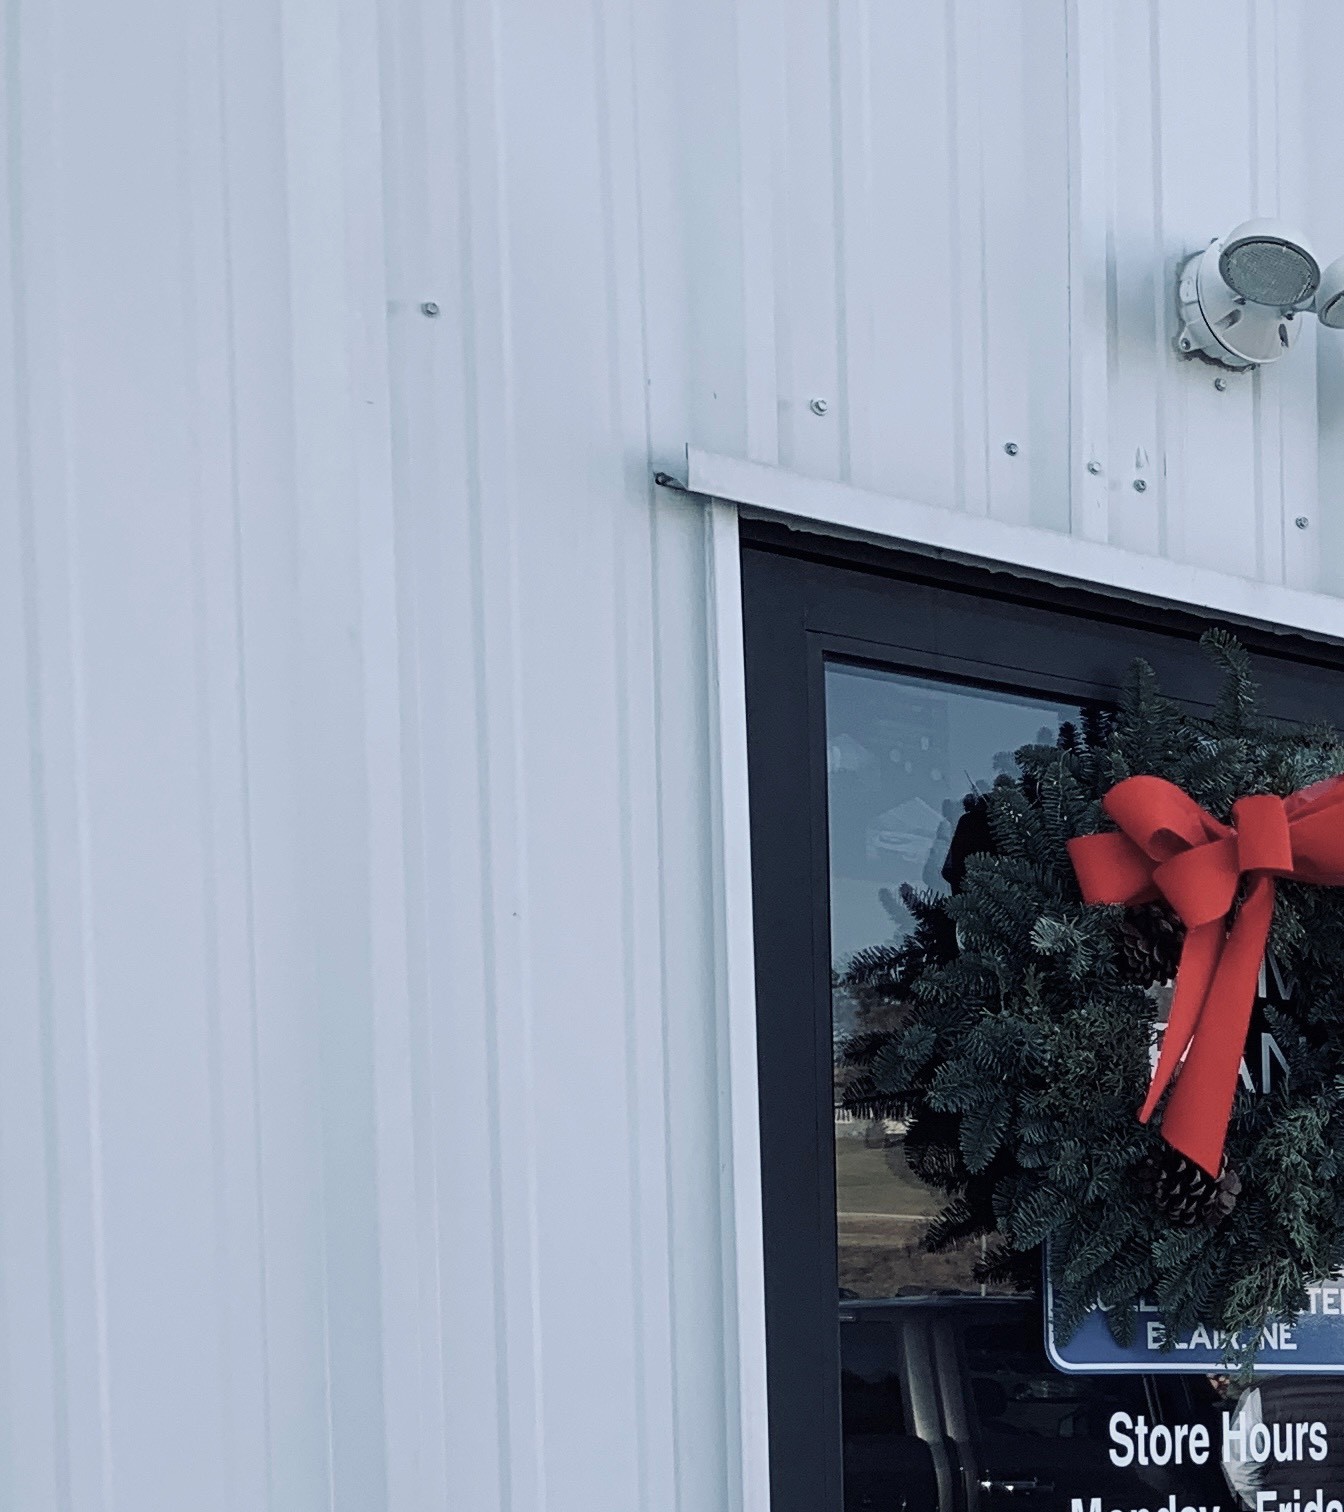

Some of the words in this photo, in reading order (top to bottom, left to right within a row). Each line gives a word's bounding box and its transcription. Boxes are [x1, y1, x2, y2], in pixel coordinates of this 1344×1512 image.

[1260, 1322, 1297, 1350] NE
[1109, 1411, 1210, 1467] Store
[1222, 1411, 1328, 1462] Hours
